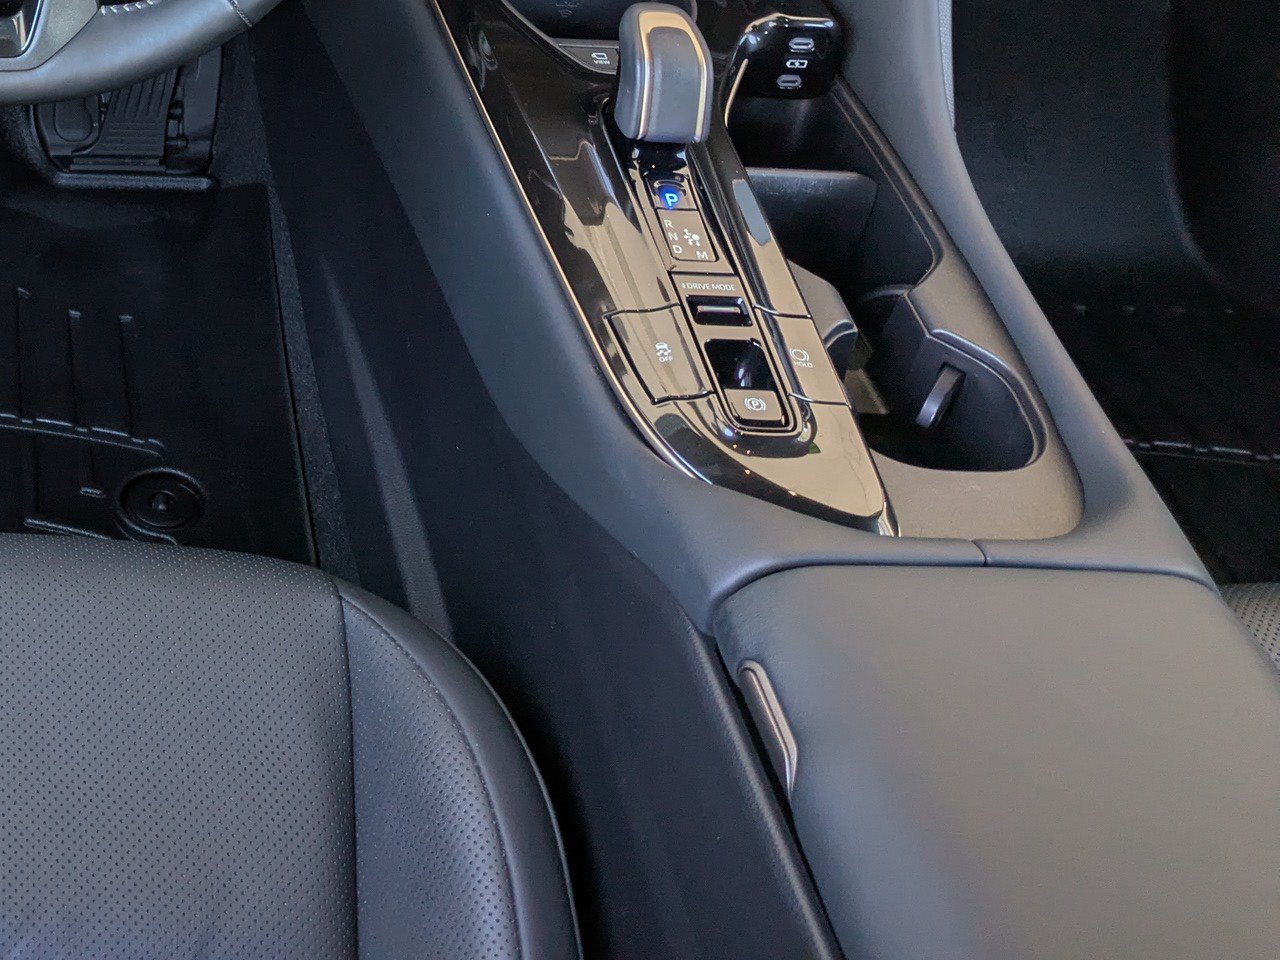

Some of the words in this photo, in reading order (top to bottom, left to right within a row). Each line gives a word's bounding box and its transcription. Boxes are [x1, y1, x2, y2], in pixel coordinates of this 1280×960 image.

[665, 192, 678, 206] P
[664, 219, 673, 229] R
[669, 232, 678, 241] N
[673, 244, 683, 254] D
[697, 250, 708, 260] M
[687, 282, 710, 291] DRIVE
[711, 283, 736, 292] MODE
[794, 360, 814, 369] HOLD
